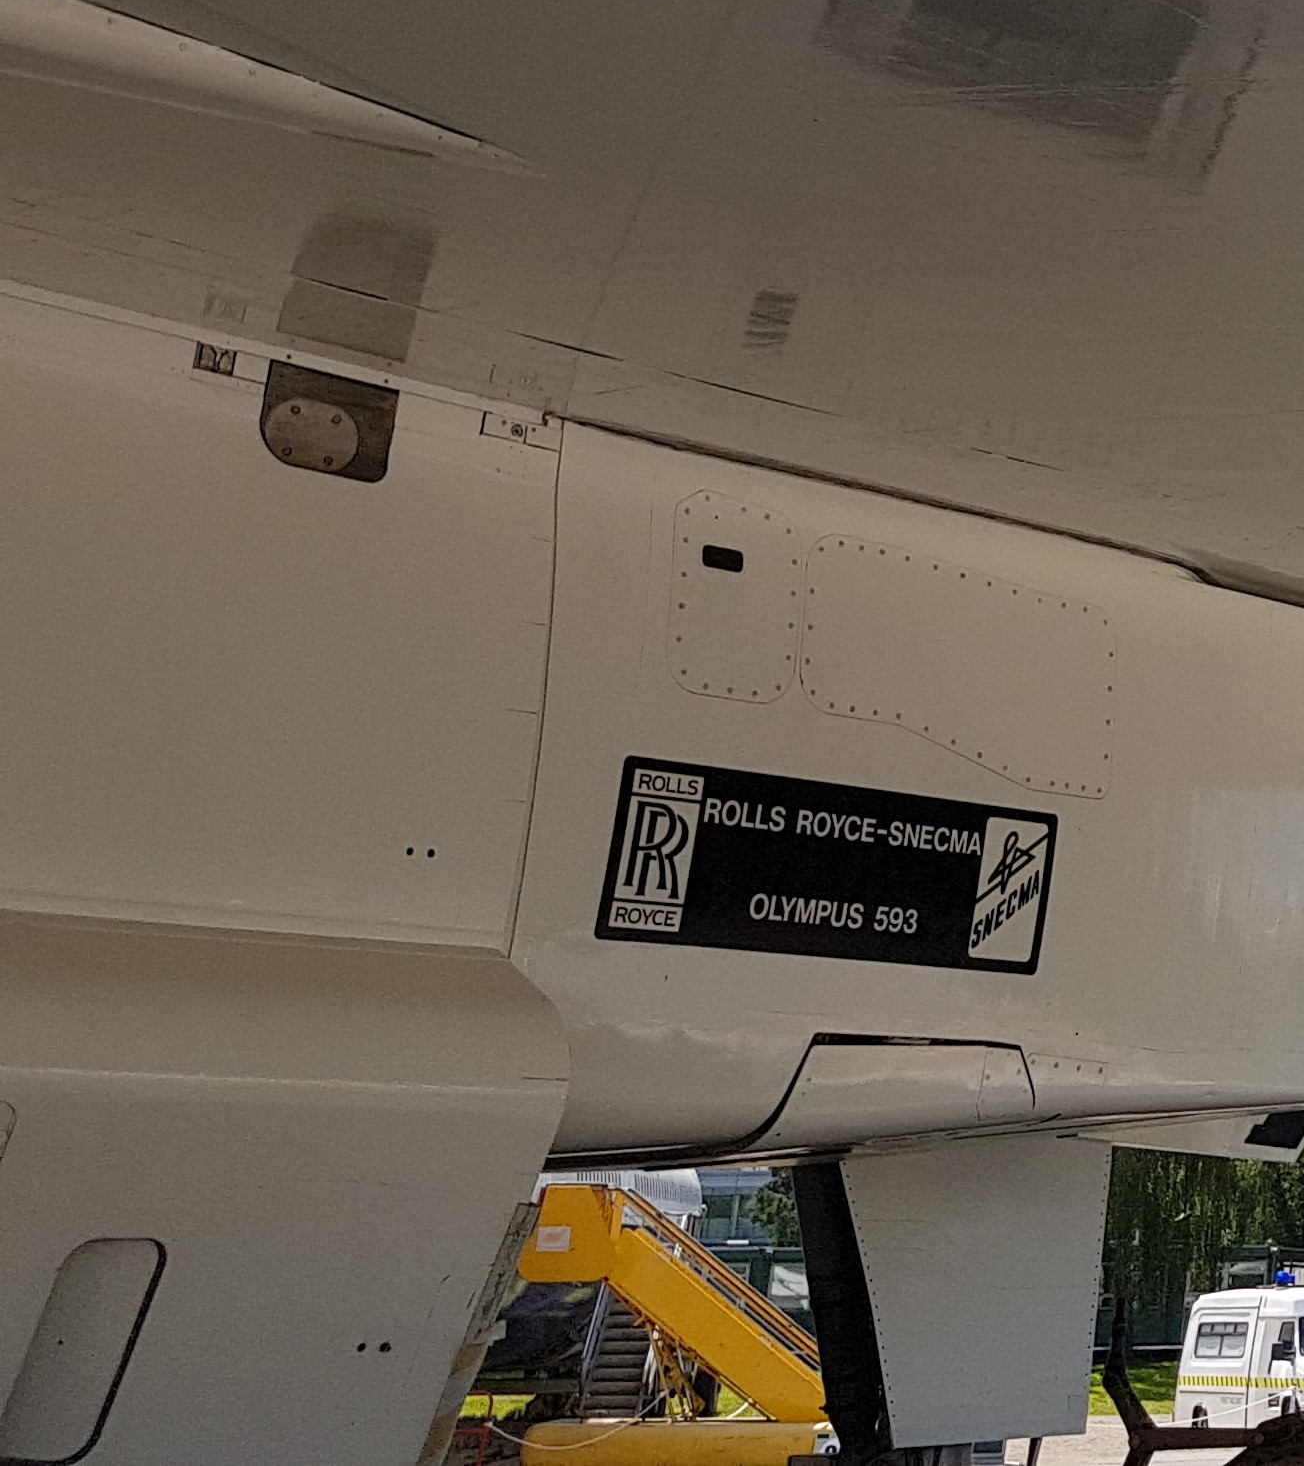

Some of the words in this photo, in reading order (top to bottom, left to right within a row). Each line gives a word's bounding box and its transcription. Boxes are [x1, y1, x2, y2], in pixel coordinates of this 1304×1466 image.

[638, 773, 699, 796] ROLLS
[703, 798, 787, 832] ROLLS
[796, 809, 982, 856] ROYCE-SNECMA
[613, 906, 678, 927] ROYCE
[749, 892, 865, 930] OLYMPUS
[873, 906, 918, 935] 593
[971, 869, 1041, 949] SNECMA
